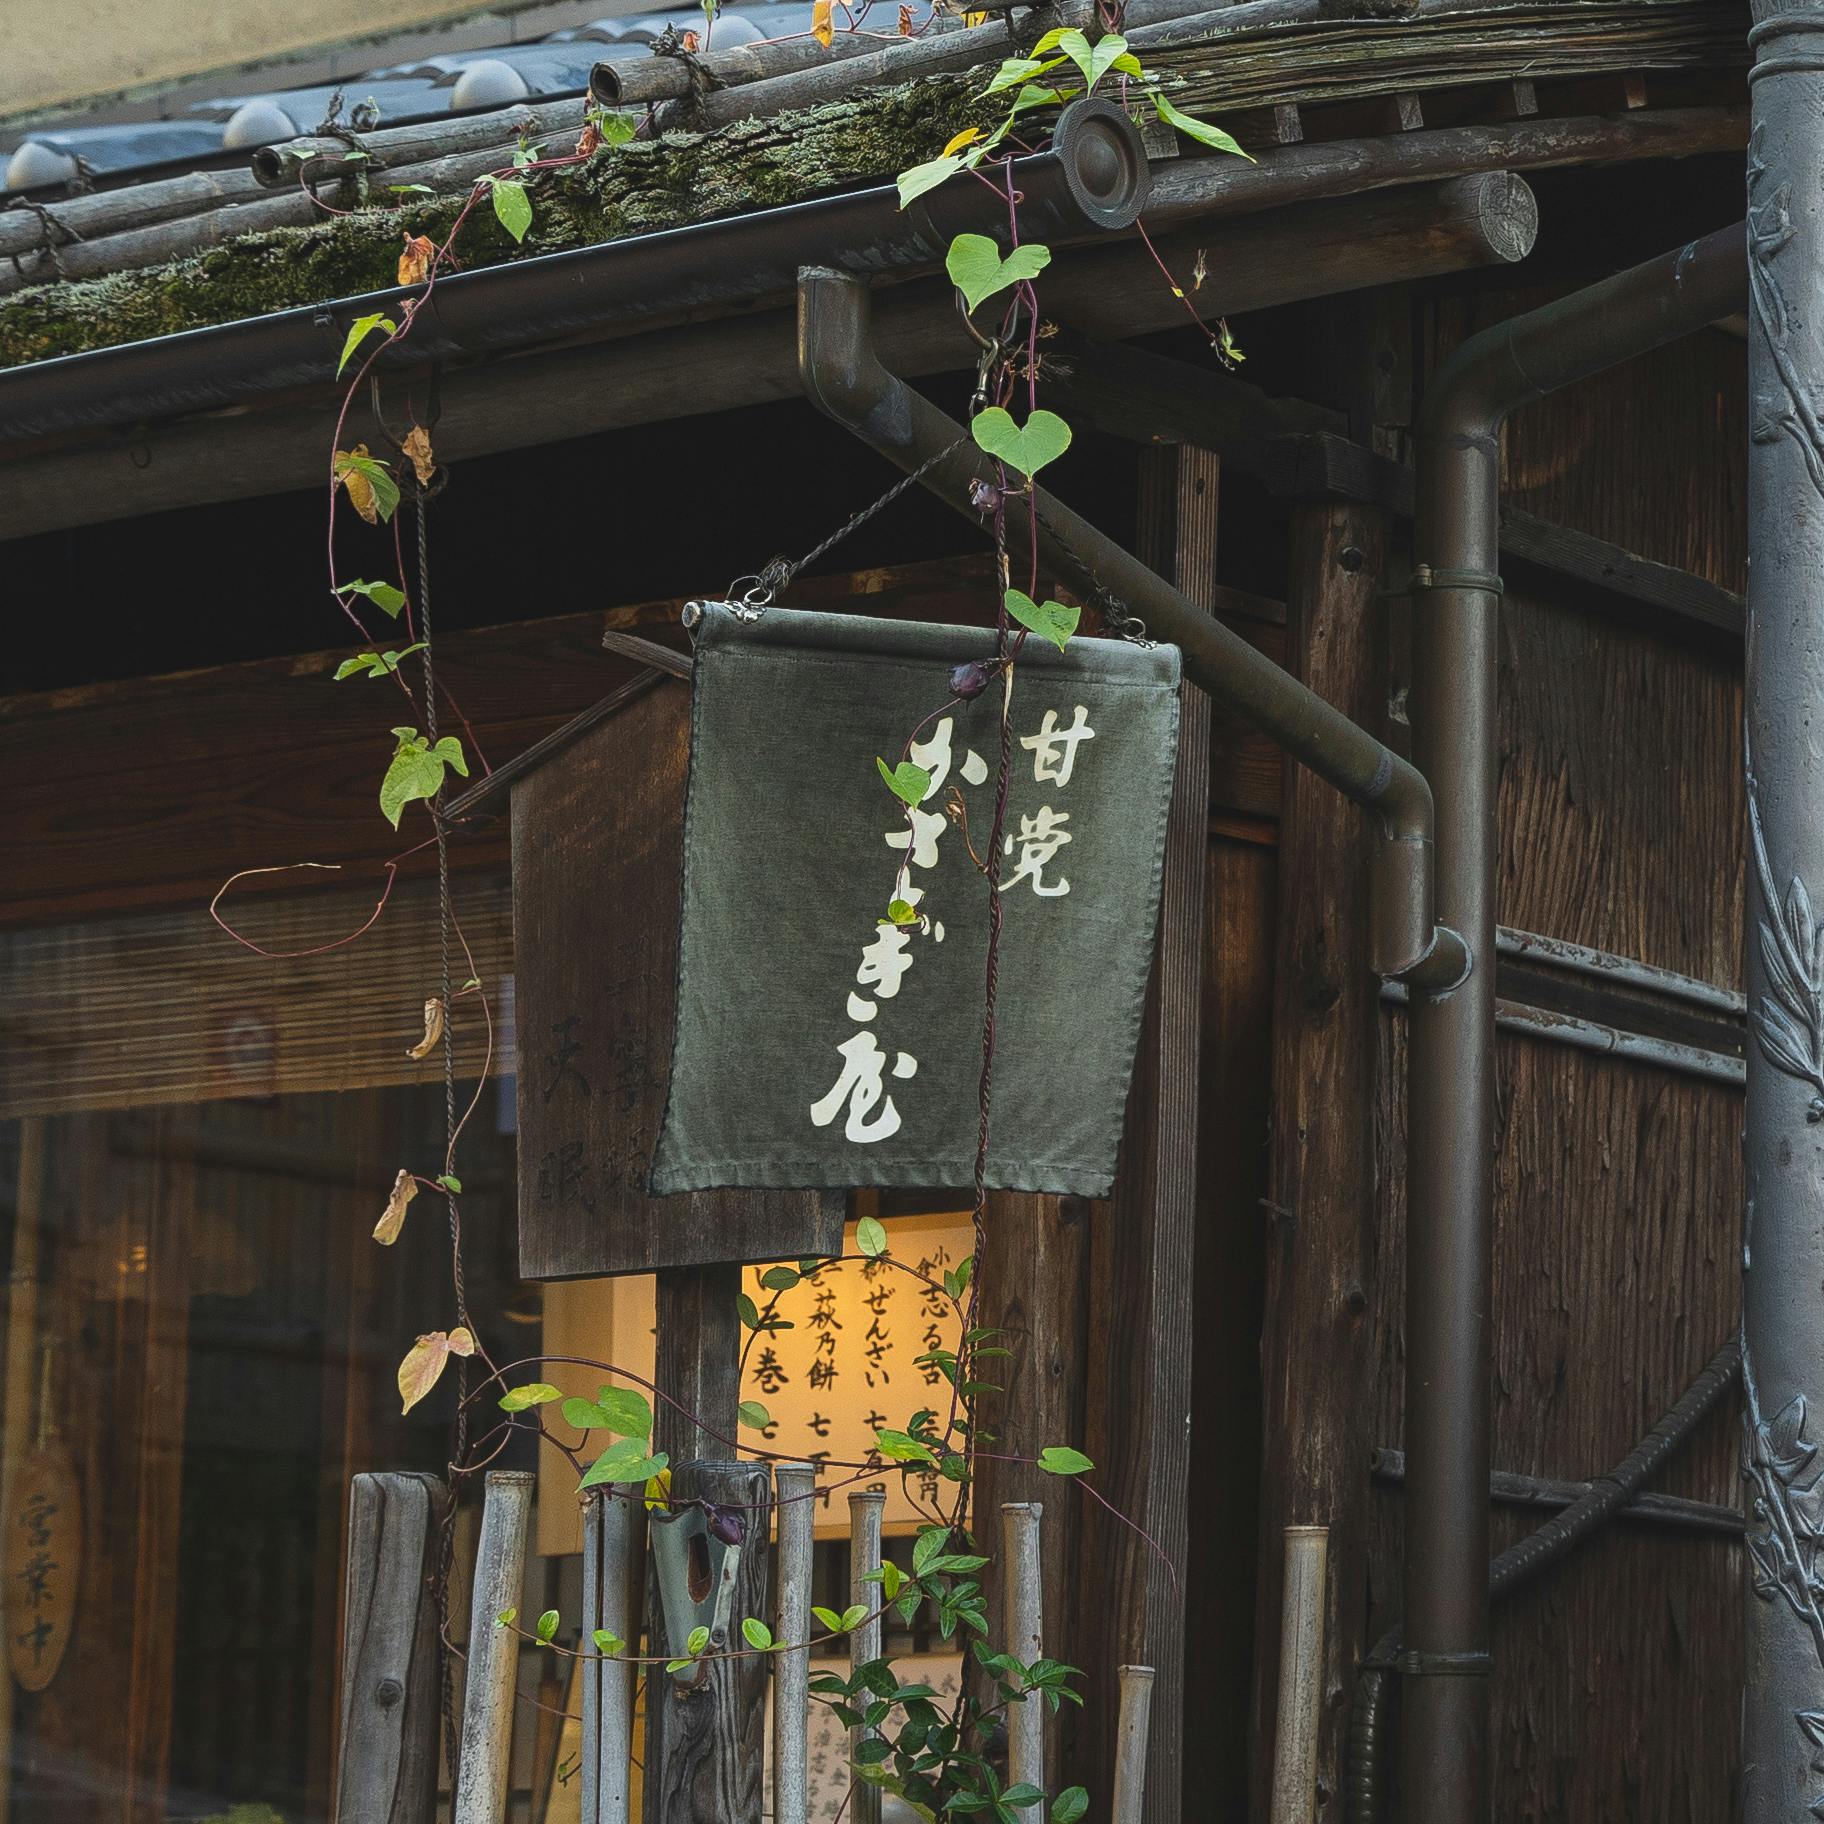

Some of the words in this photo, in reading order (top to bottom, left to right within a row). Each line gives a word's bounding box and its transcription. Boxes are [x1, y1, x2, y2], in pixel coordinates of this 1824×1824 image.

[998, 705, 1095, 897] 甘党
[810, 716, 988, 1144] かさぎ屋
[16, 1493, 60, 1667] 営業中
